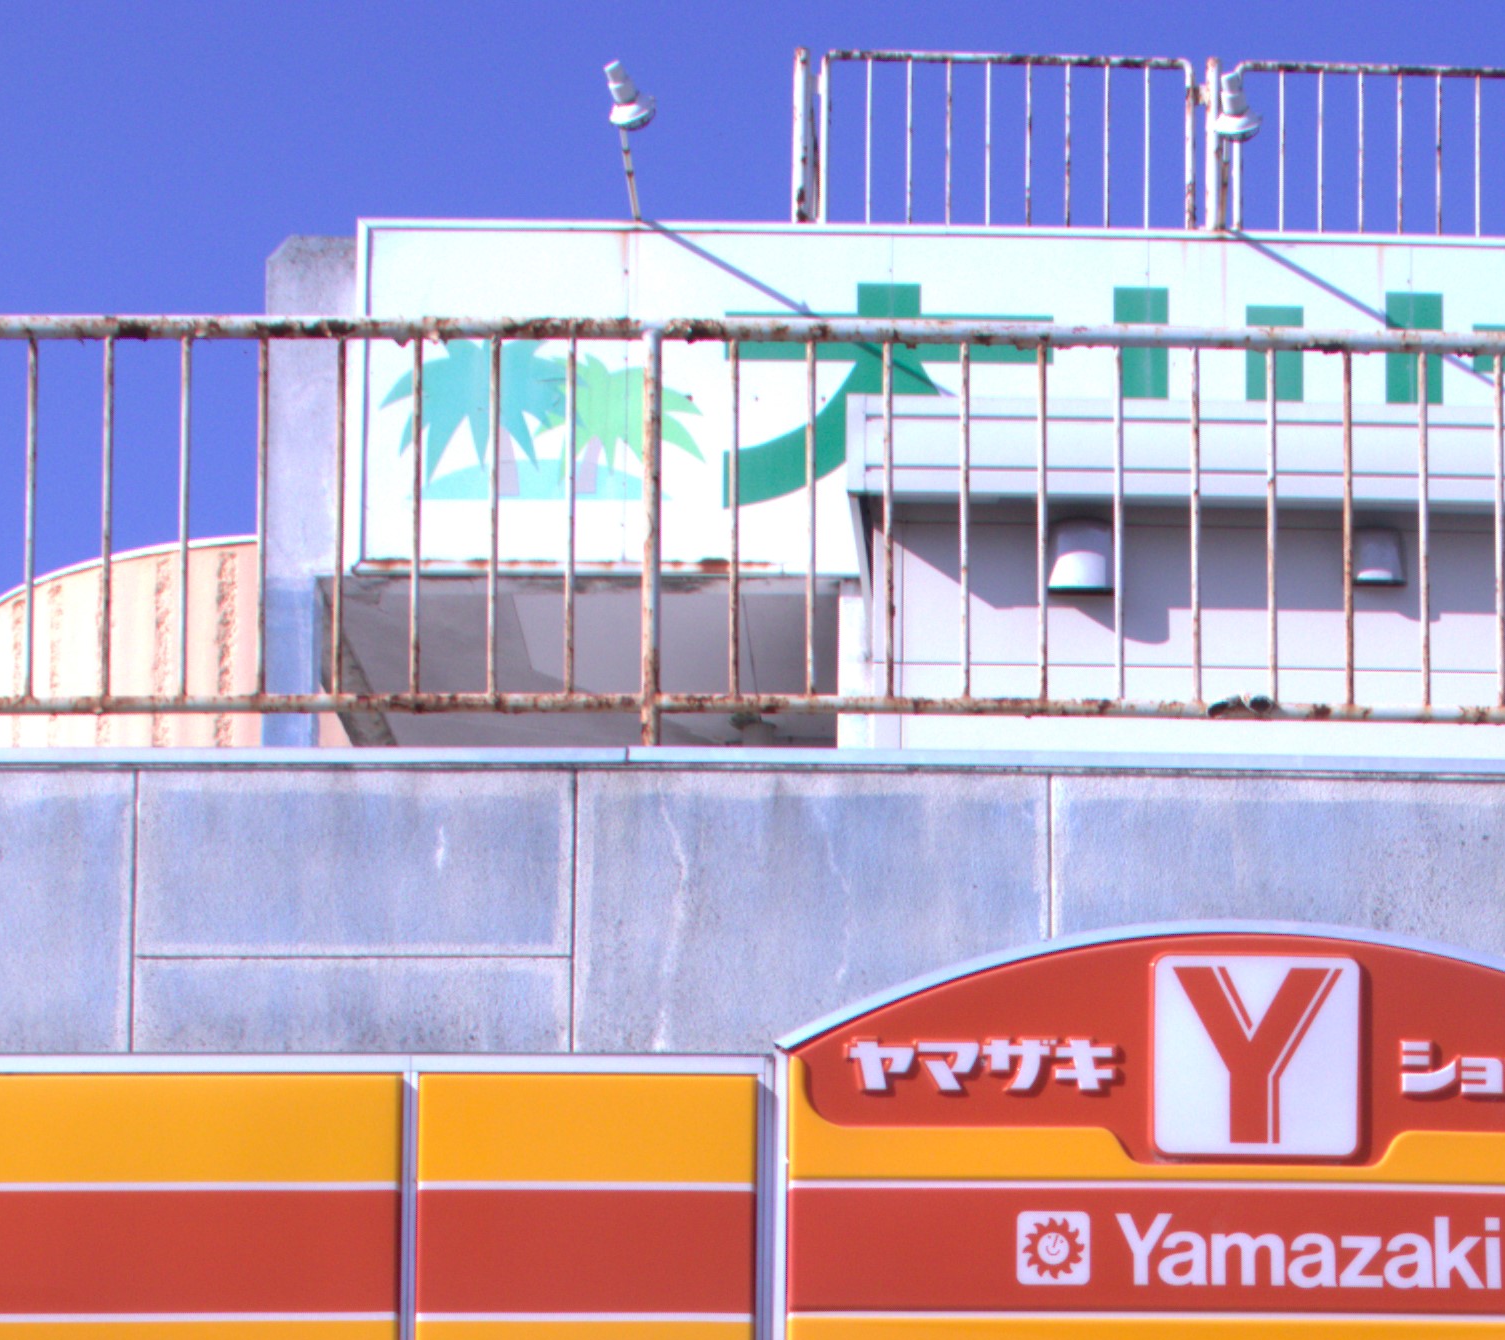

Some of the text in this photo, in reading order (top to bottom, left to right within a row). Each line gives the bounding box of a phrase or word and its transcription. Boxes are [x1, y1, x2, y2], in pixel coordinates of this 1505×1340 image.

[846, 1037, 1122, 1095] ヤマザキ
[1172, 966, 1344, 1144] Y
[1115, 1213, 1503, 1289] Yamazaki
